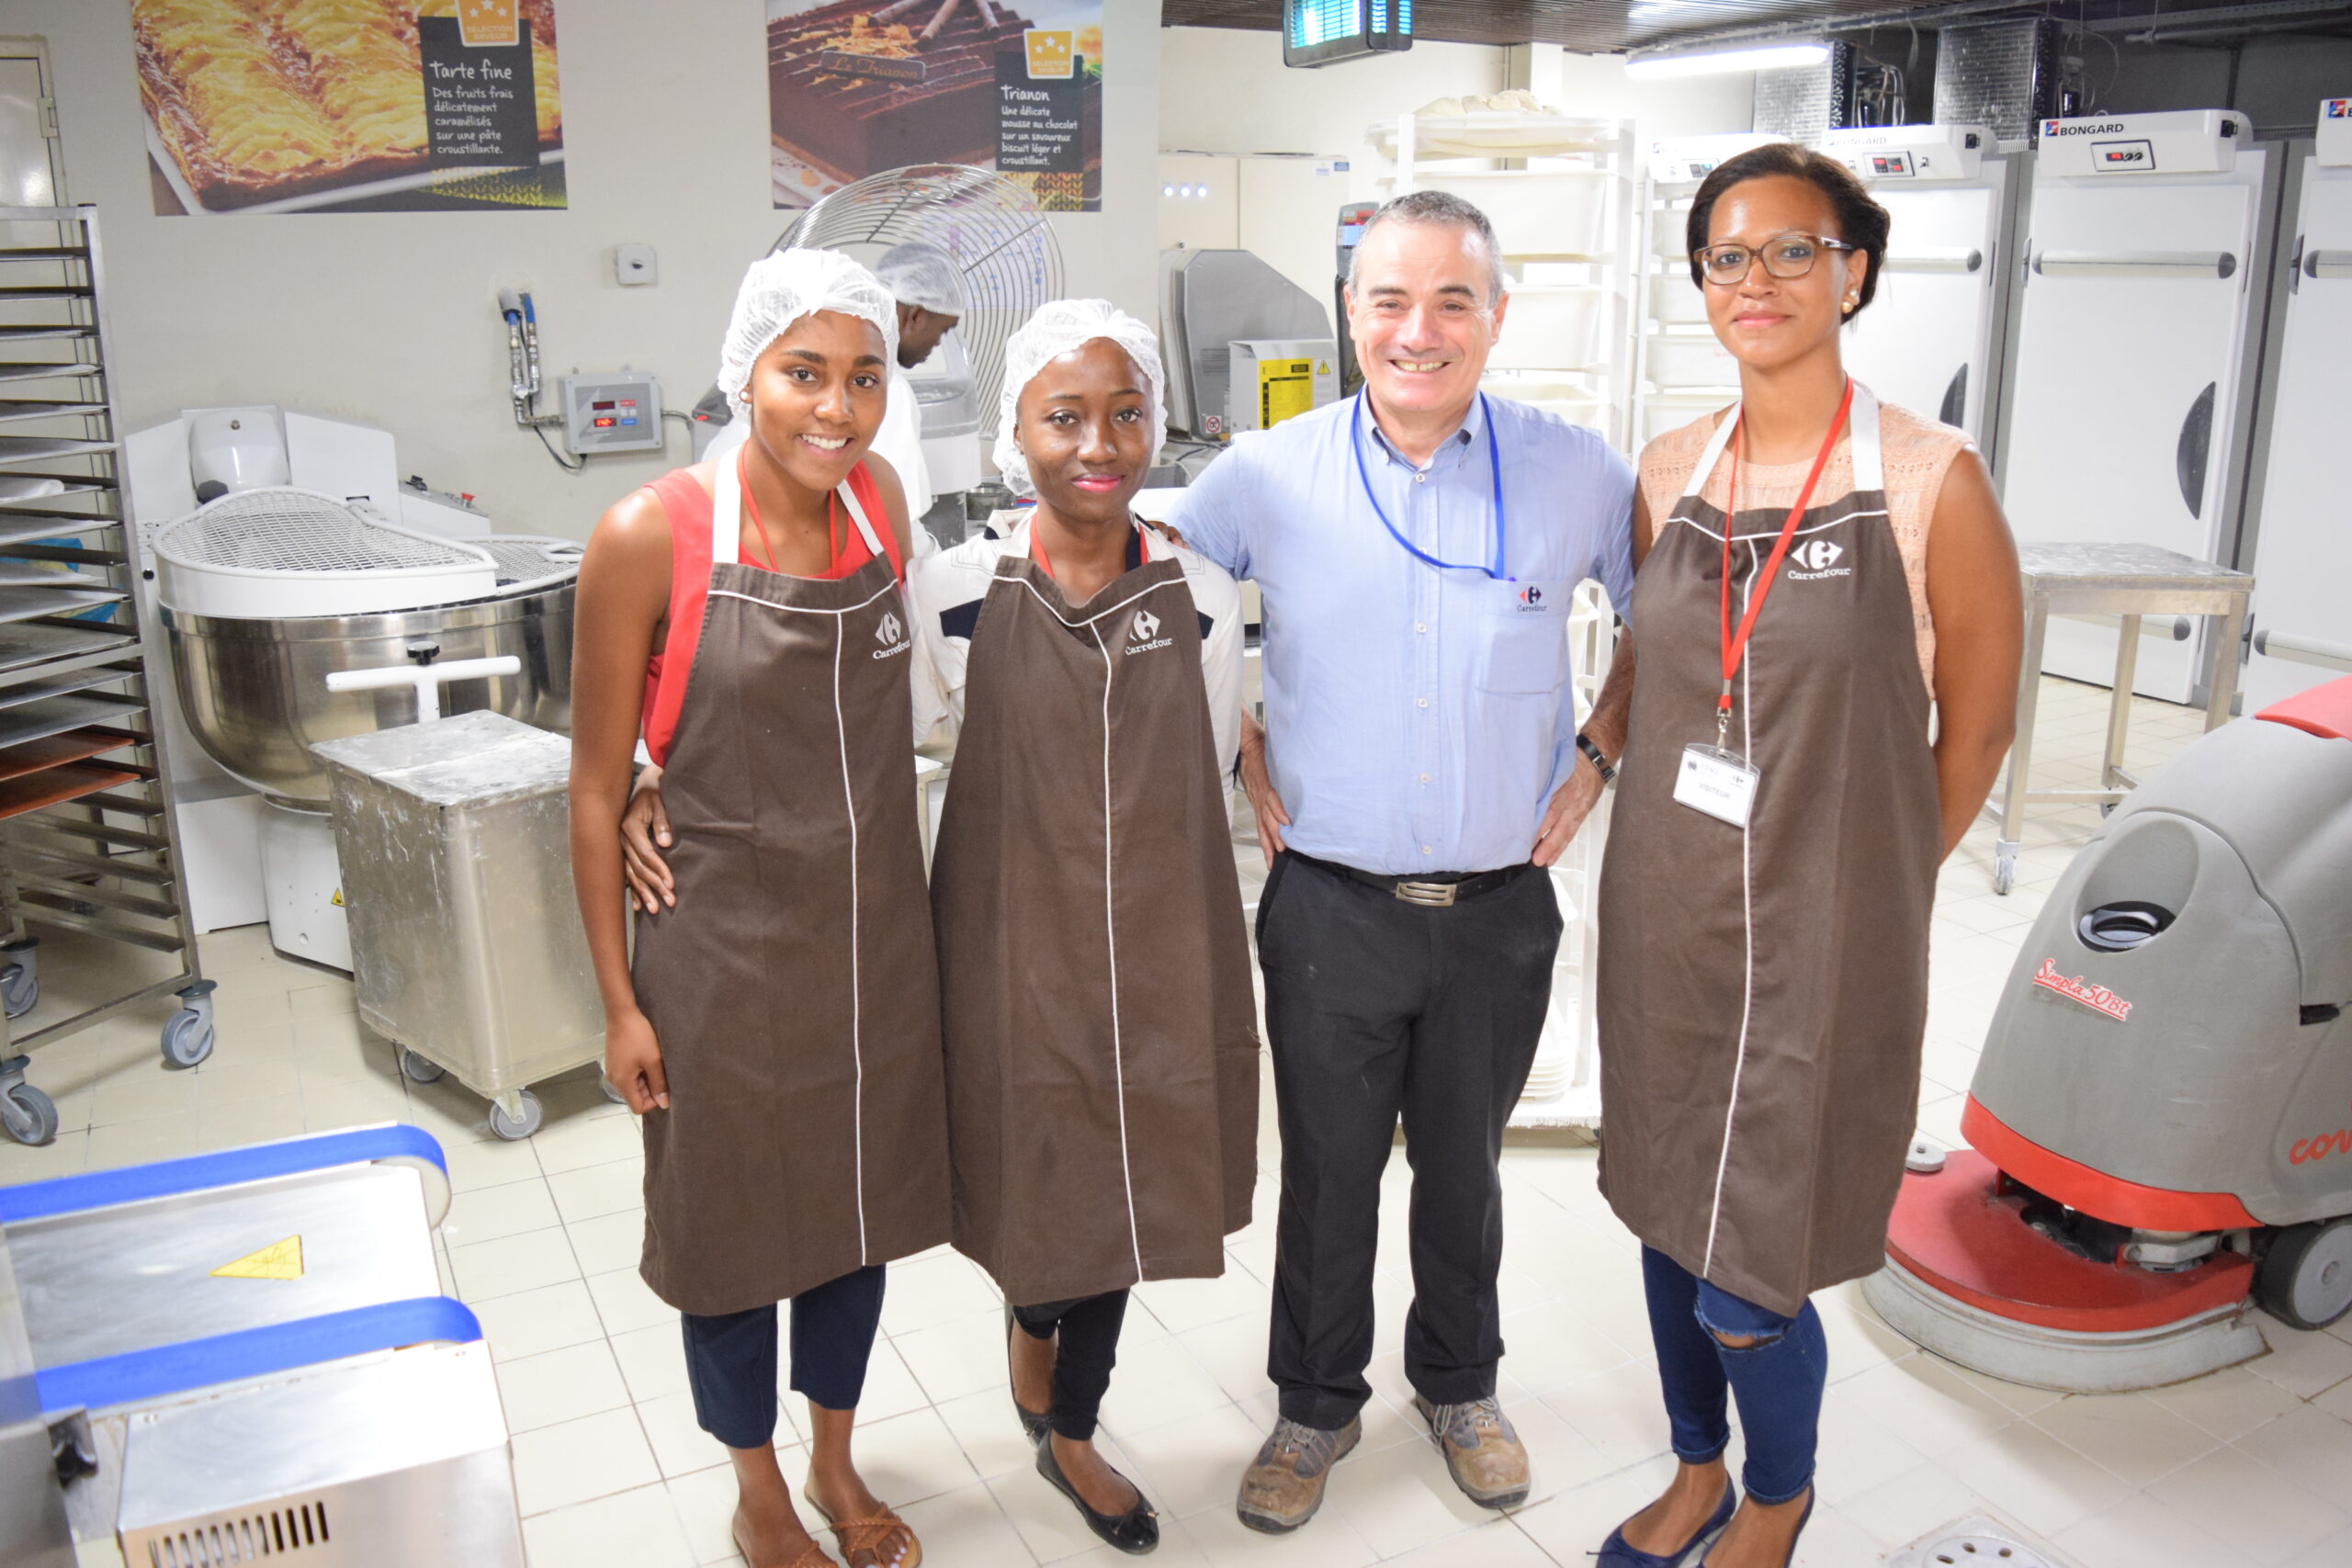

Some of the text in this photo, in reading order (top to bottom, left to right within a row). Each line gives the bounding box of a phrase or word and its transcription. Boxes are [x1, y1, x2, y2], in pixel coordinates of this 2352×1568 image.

[429, 59, 512, 80] Tarte fine
[432, 85, 514, 99] Des fruits frais
[1000, 85, 1050, 101] Trianon
[434, 101, 497, 112] délicatement
[1001, 105, 1050, 117] Une délicate
[435, 115, 492, 126] caramélisés
[1046, 118, 1078, 130] chocolat
[2059, 123, 2124, 136] BONGARD
[436, 130, 502, 143] sur une pâte
[1032, 133, 1071, 141] savoureux
[437, 142, 503, 154] croustillante.
[1001, 141, 1061, 156] biscuit léger et
[1001, 155, 1050, 165] croustillant.
[1787, 568, 1852, 581] Carrefour
[1517, 604, 1547, 613] Carrefour
[1125, 637, 1173, 656] Carrefour
[2035, 958, 2084, 996] Simpla
